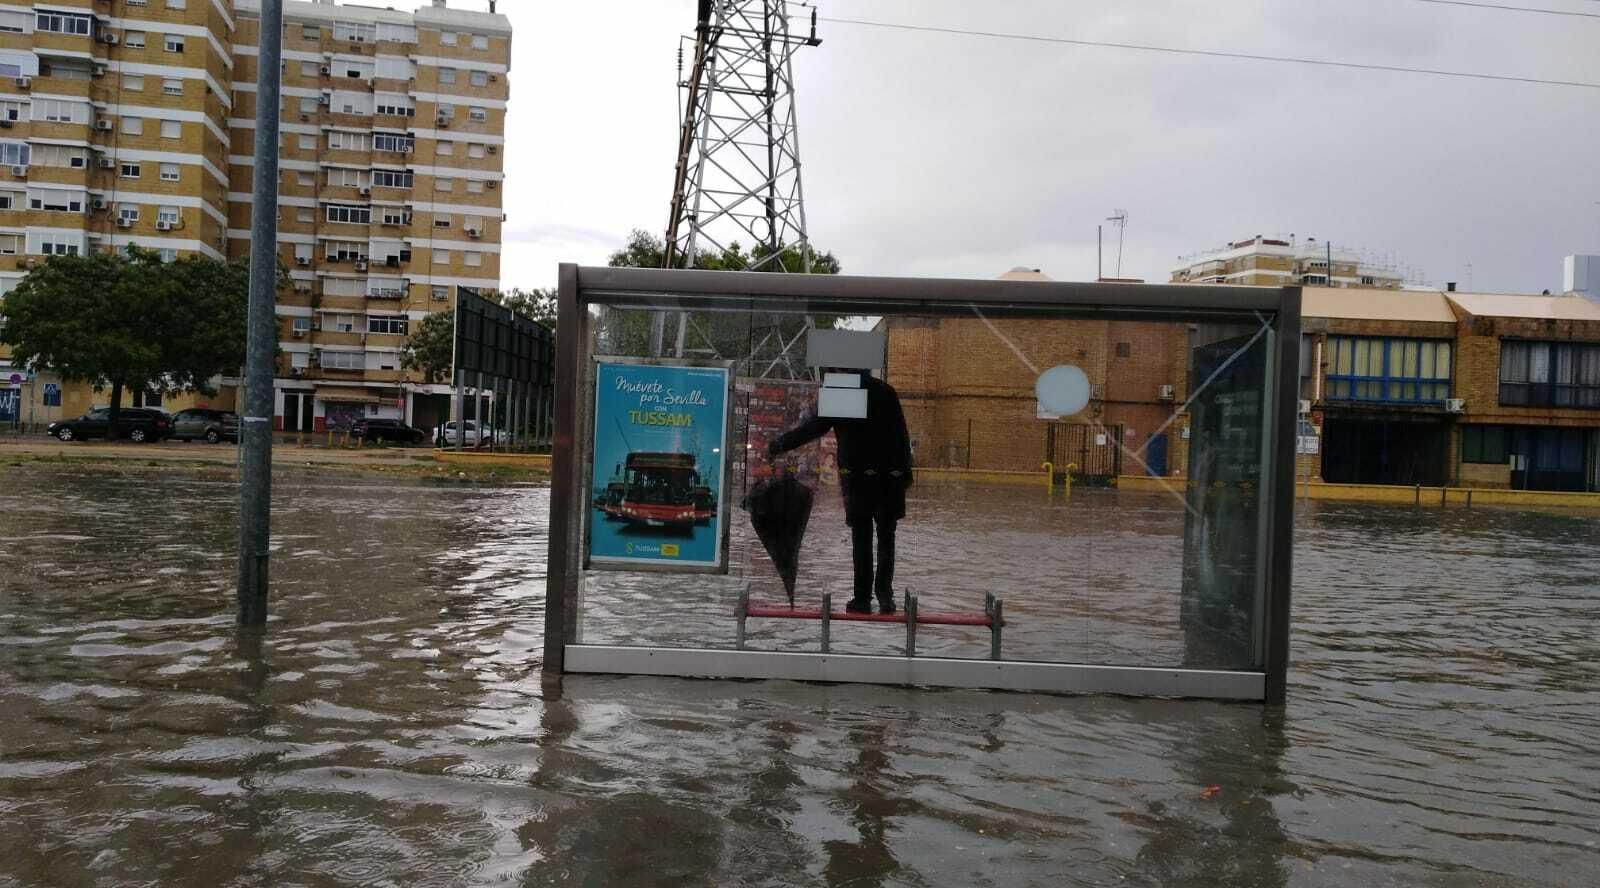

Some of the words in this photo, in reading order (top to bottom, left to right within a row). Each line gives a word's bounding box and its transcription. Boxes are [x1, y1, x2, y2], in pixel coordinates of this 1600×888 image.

[640, 393, 661, 408] por
[663, 389, 707, 406] Sevilla
[629, 410, 692, 427] TUSSAM
